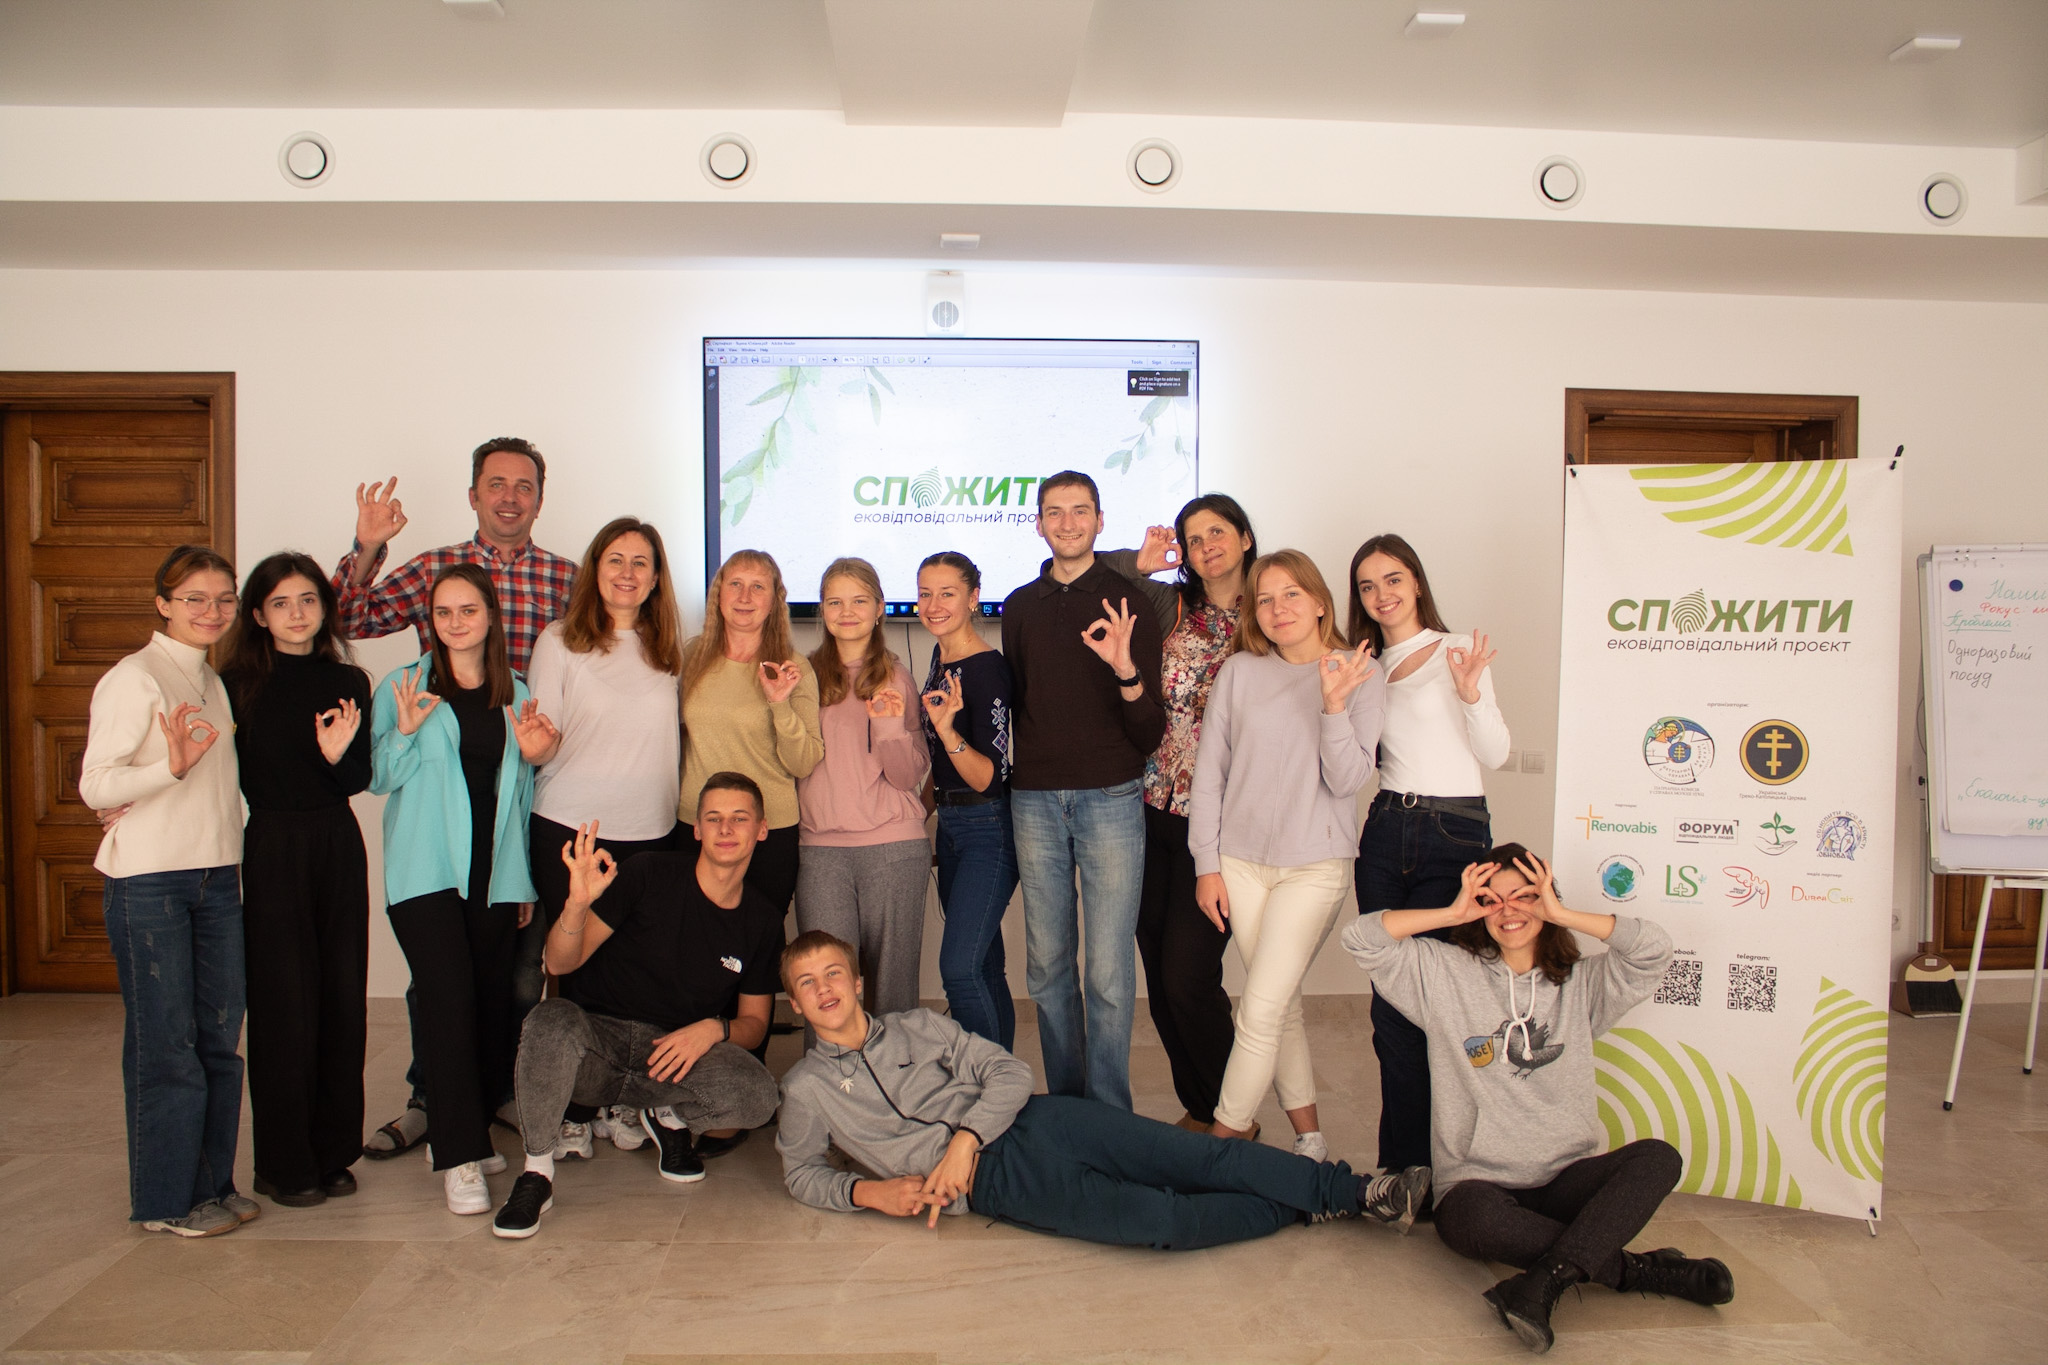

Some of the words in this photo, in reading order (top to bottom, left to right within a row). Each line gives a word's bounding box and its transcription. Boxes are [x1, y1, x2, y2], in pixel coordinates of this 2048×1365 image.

[854, 510, 1003, 525] ековідповідальний
[1007, 513, 1036, 526] про
[1607, 588, 1854, 635] СПОЖИТИ
[1980, 602, 2021, 619] Фокус
[1607, 637, 1778, 653] ековідповідальний
[1783, 640, 1852, 656] проєкт
[1948, 639, 2033, 666] Одноразовий
[1949, 670, 1993, 688] посуд
[1591, 819, 1658, 834] Renovabis
[1679, 822, 1734, 835] ФОРУМ
[1736, 953, 1771, 961] telegram:
